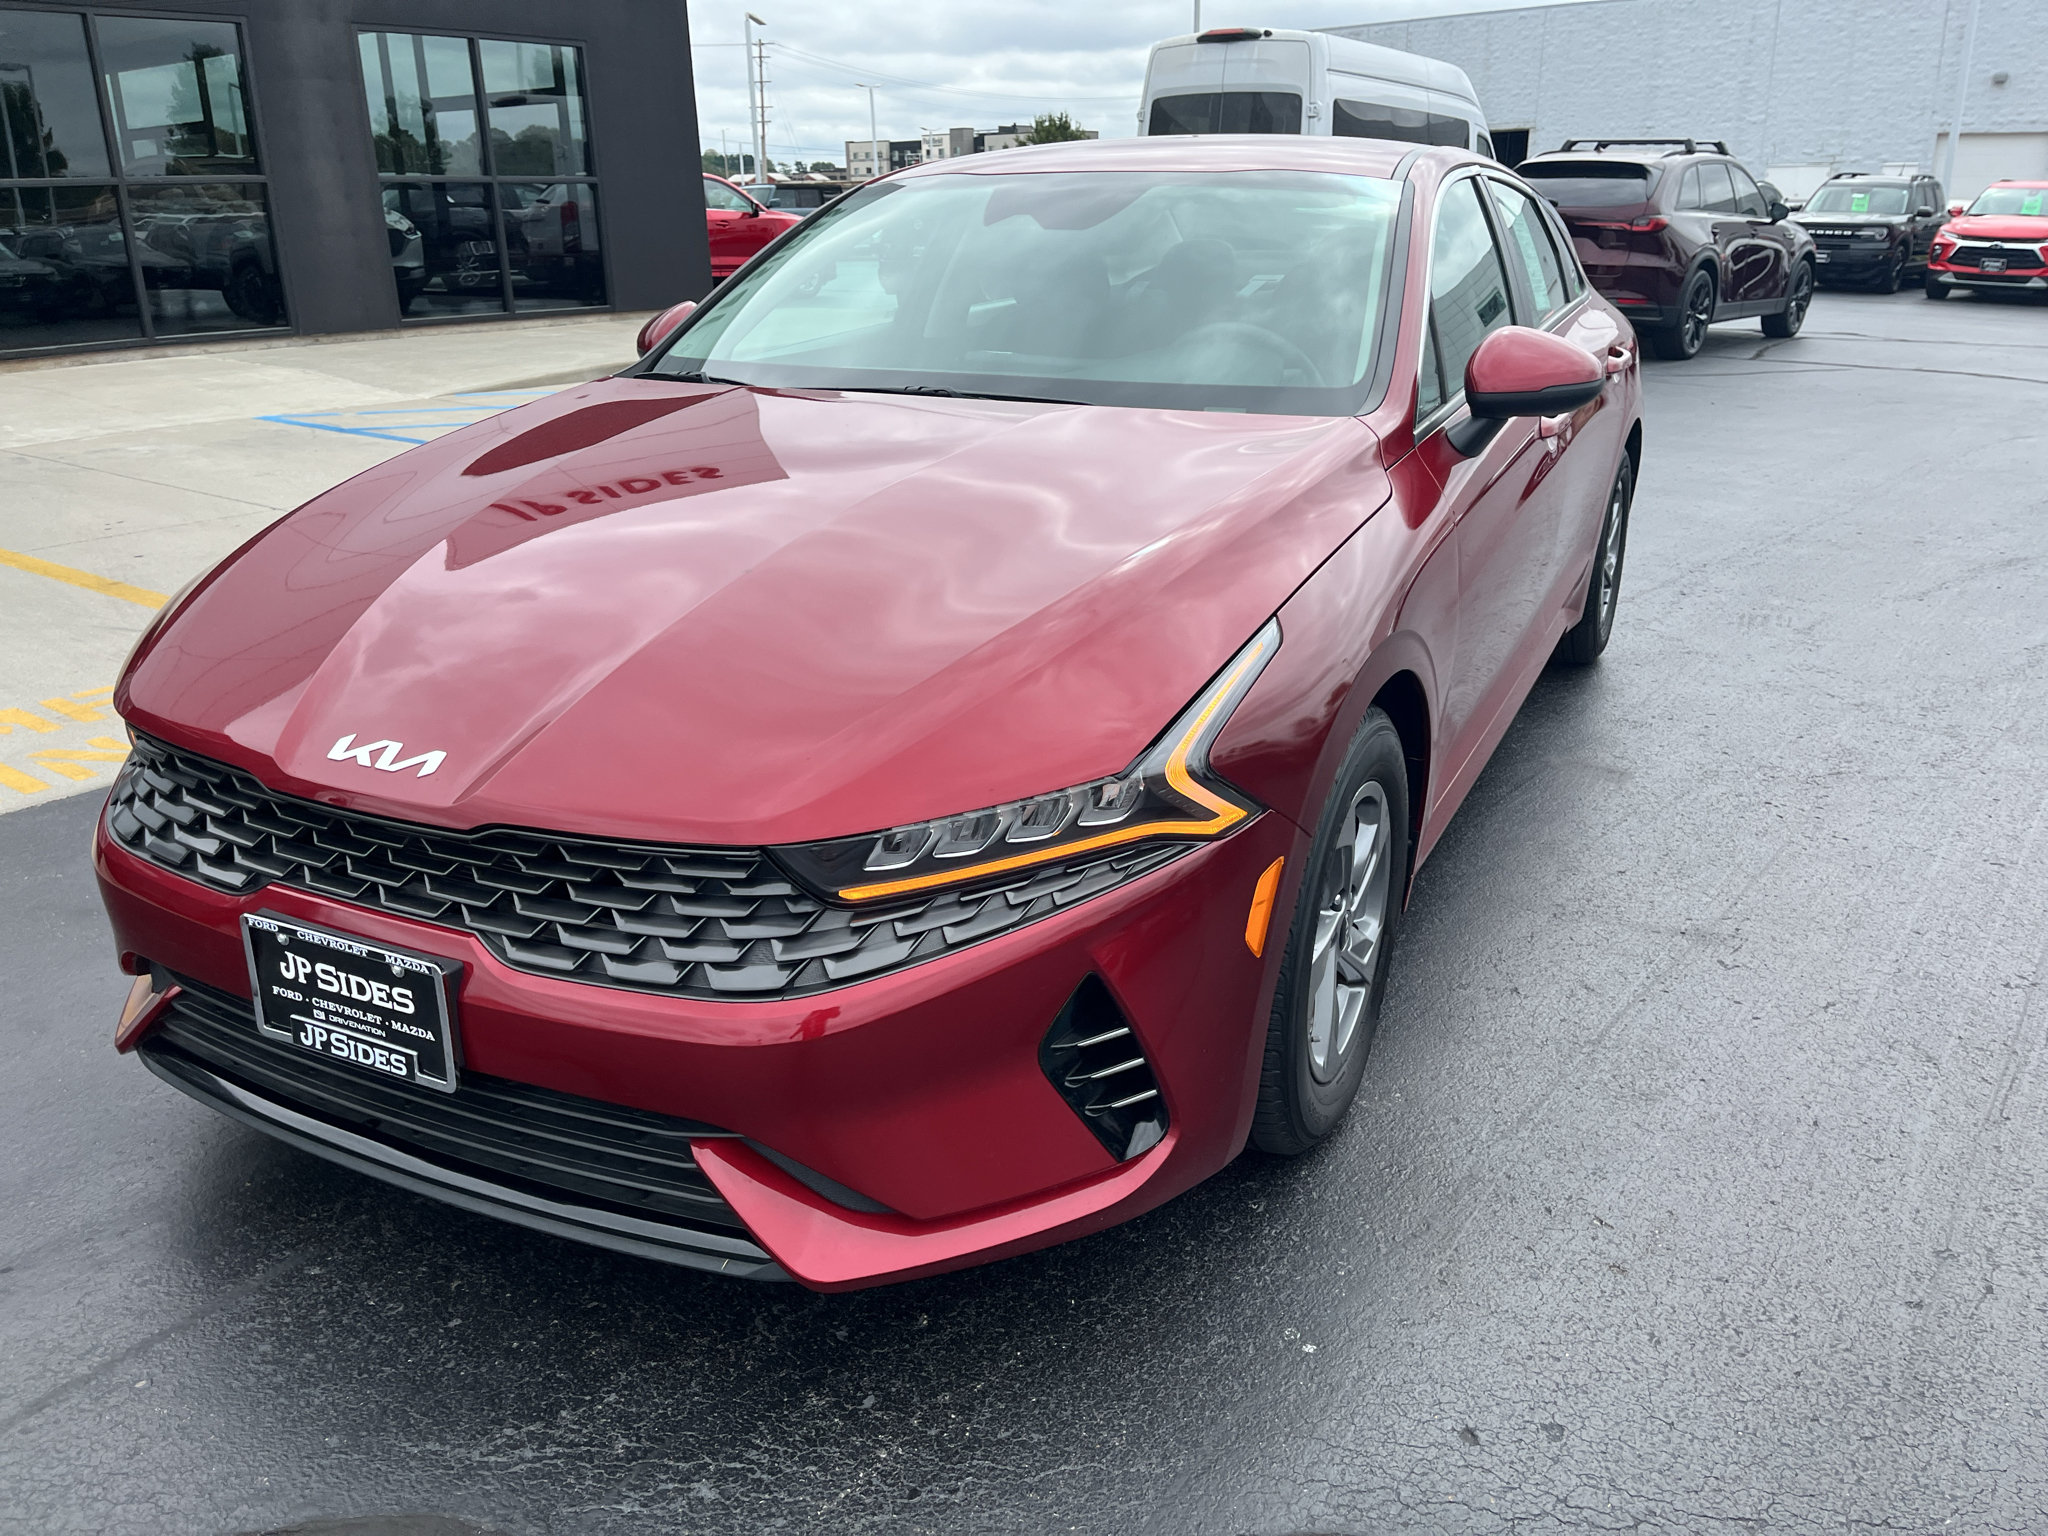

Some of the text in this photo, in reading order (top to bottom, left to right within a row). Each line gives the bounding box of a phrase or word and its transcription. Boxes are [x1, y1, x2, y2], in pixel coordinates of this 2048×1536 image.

[247, 917, 430, 974] FORD CHEVROLET MAZDA
[279, 951, 415, 1015] JP SIDES
[272, 986, 436, 1042] FORD CHEVROLET MAZDA
[328, 1014, 386, 1038] DRIVENATION
[300, 1023, 408, 1076] JP SIDES
